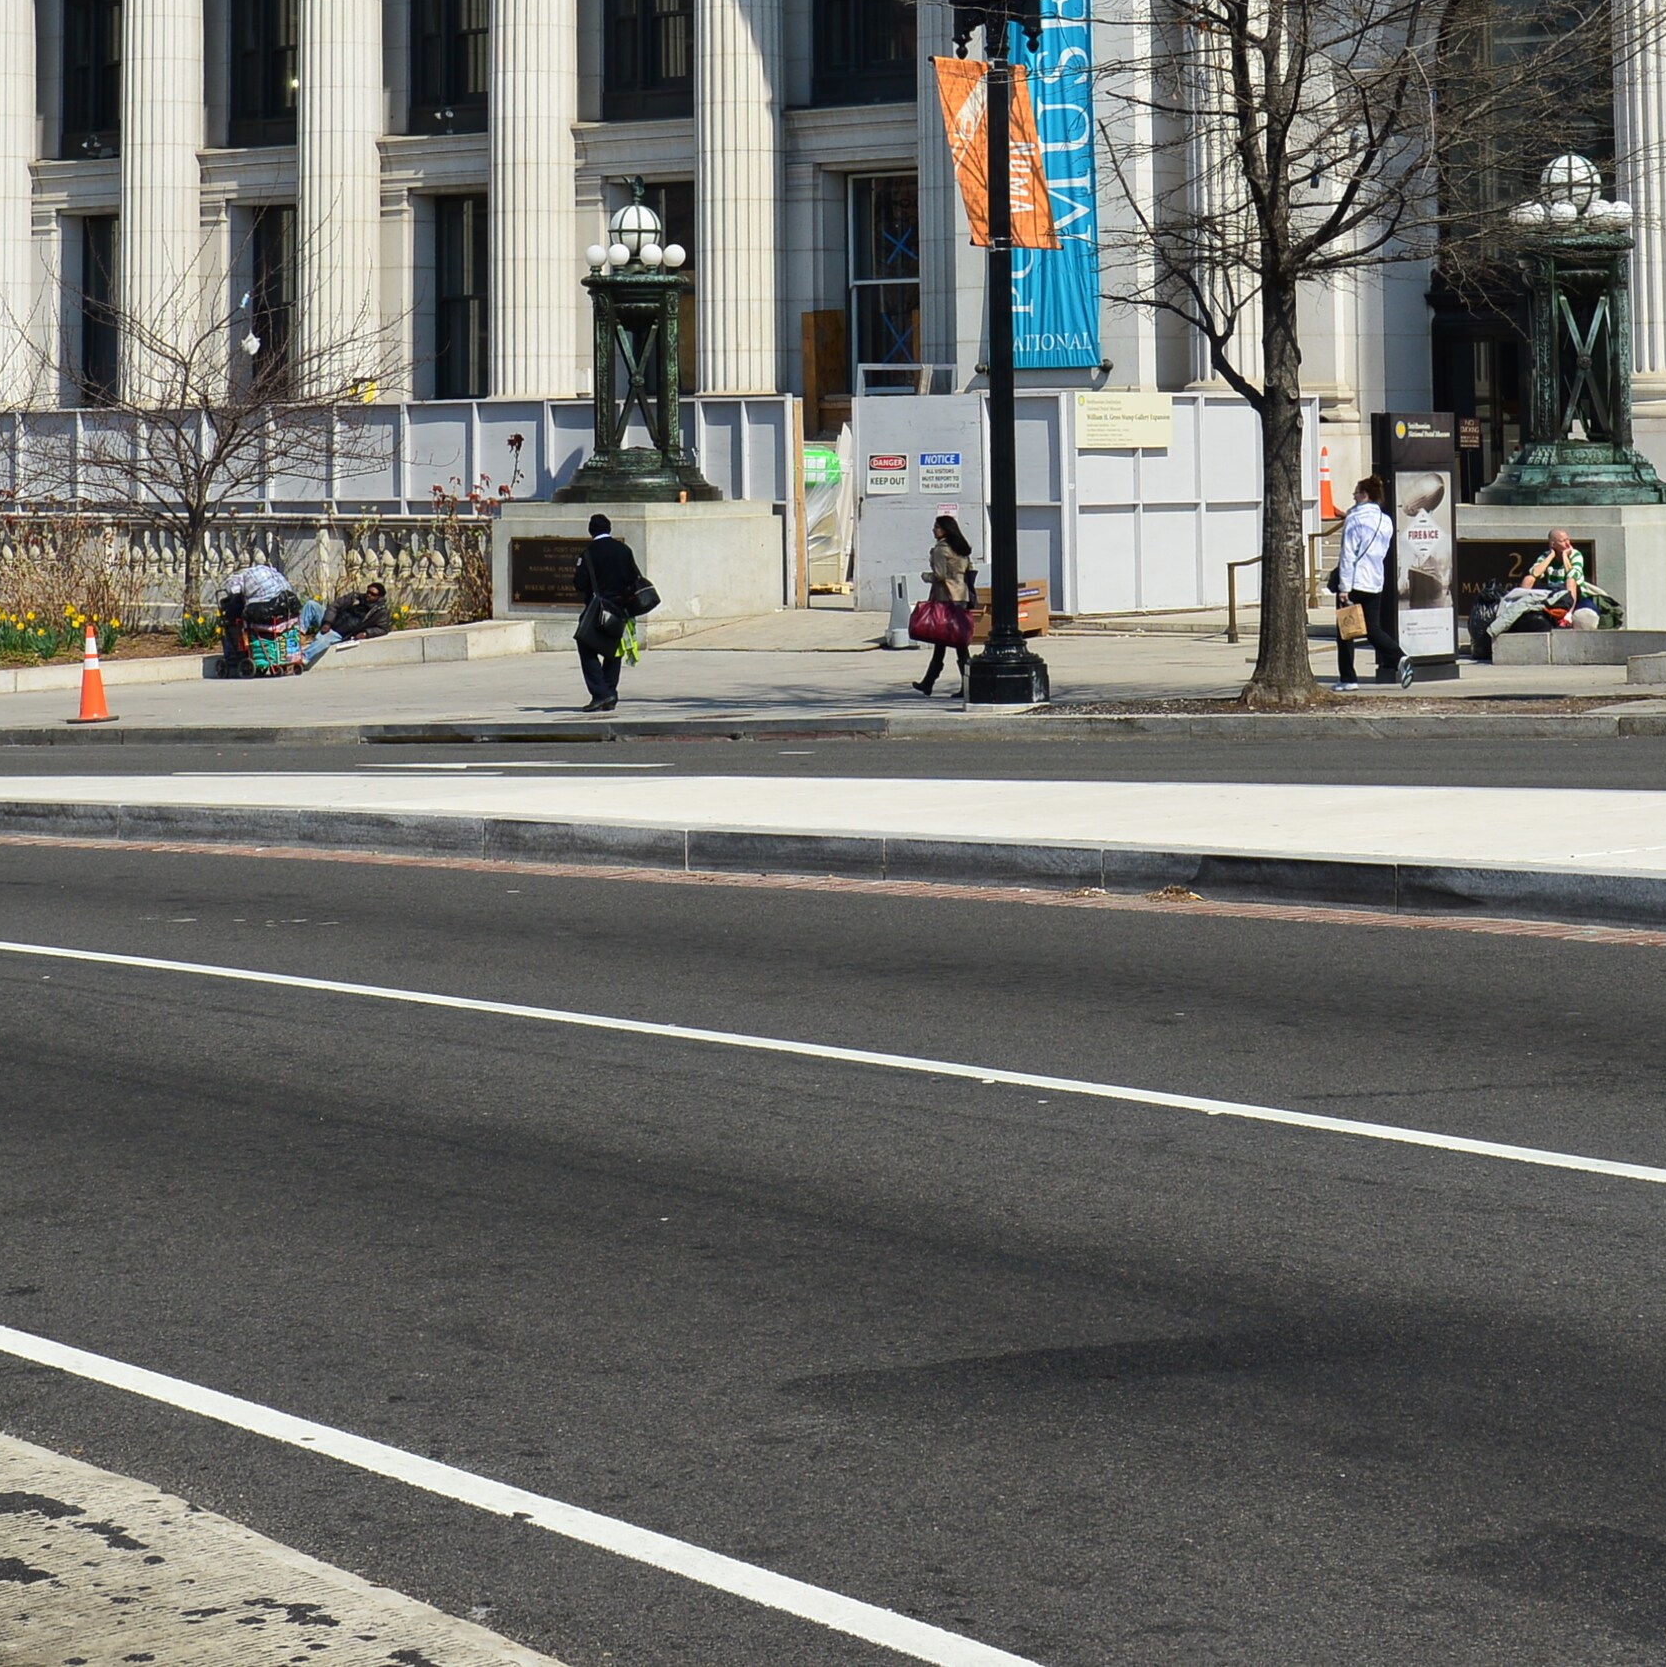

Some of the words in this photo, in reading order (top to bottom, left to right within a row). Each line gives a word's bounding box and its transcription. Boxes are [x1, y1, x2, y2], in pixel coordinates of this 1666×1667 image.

[1013, 332, 1092, 352] ATIONAL
[924, 455, 955, 464] NOTICE
[870, 477, 888, 485] KEEP
[889, 477, 905, 485] OUT
[1408, 530, 1422, 540] FIRE
[1428, 530, 1439, 539] ICE
[1508, 552, 1523, 577] 2
